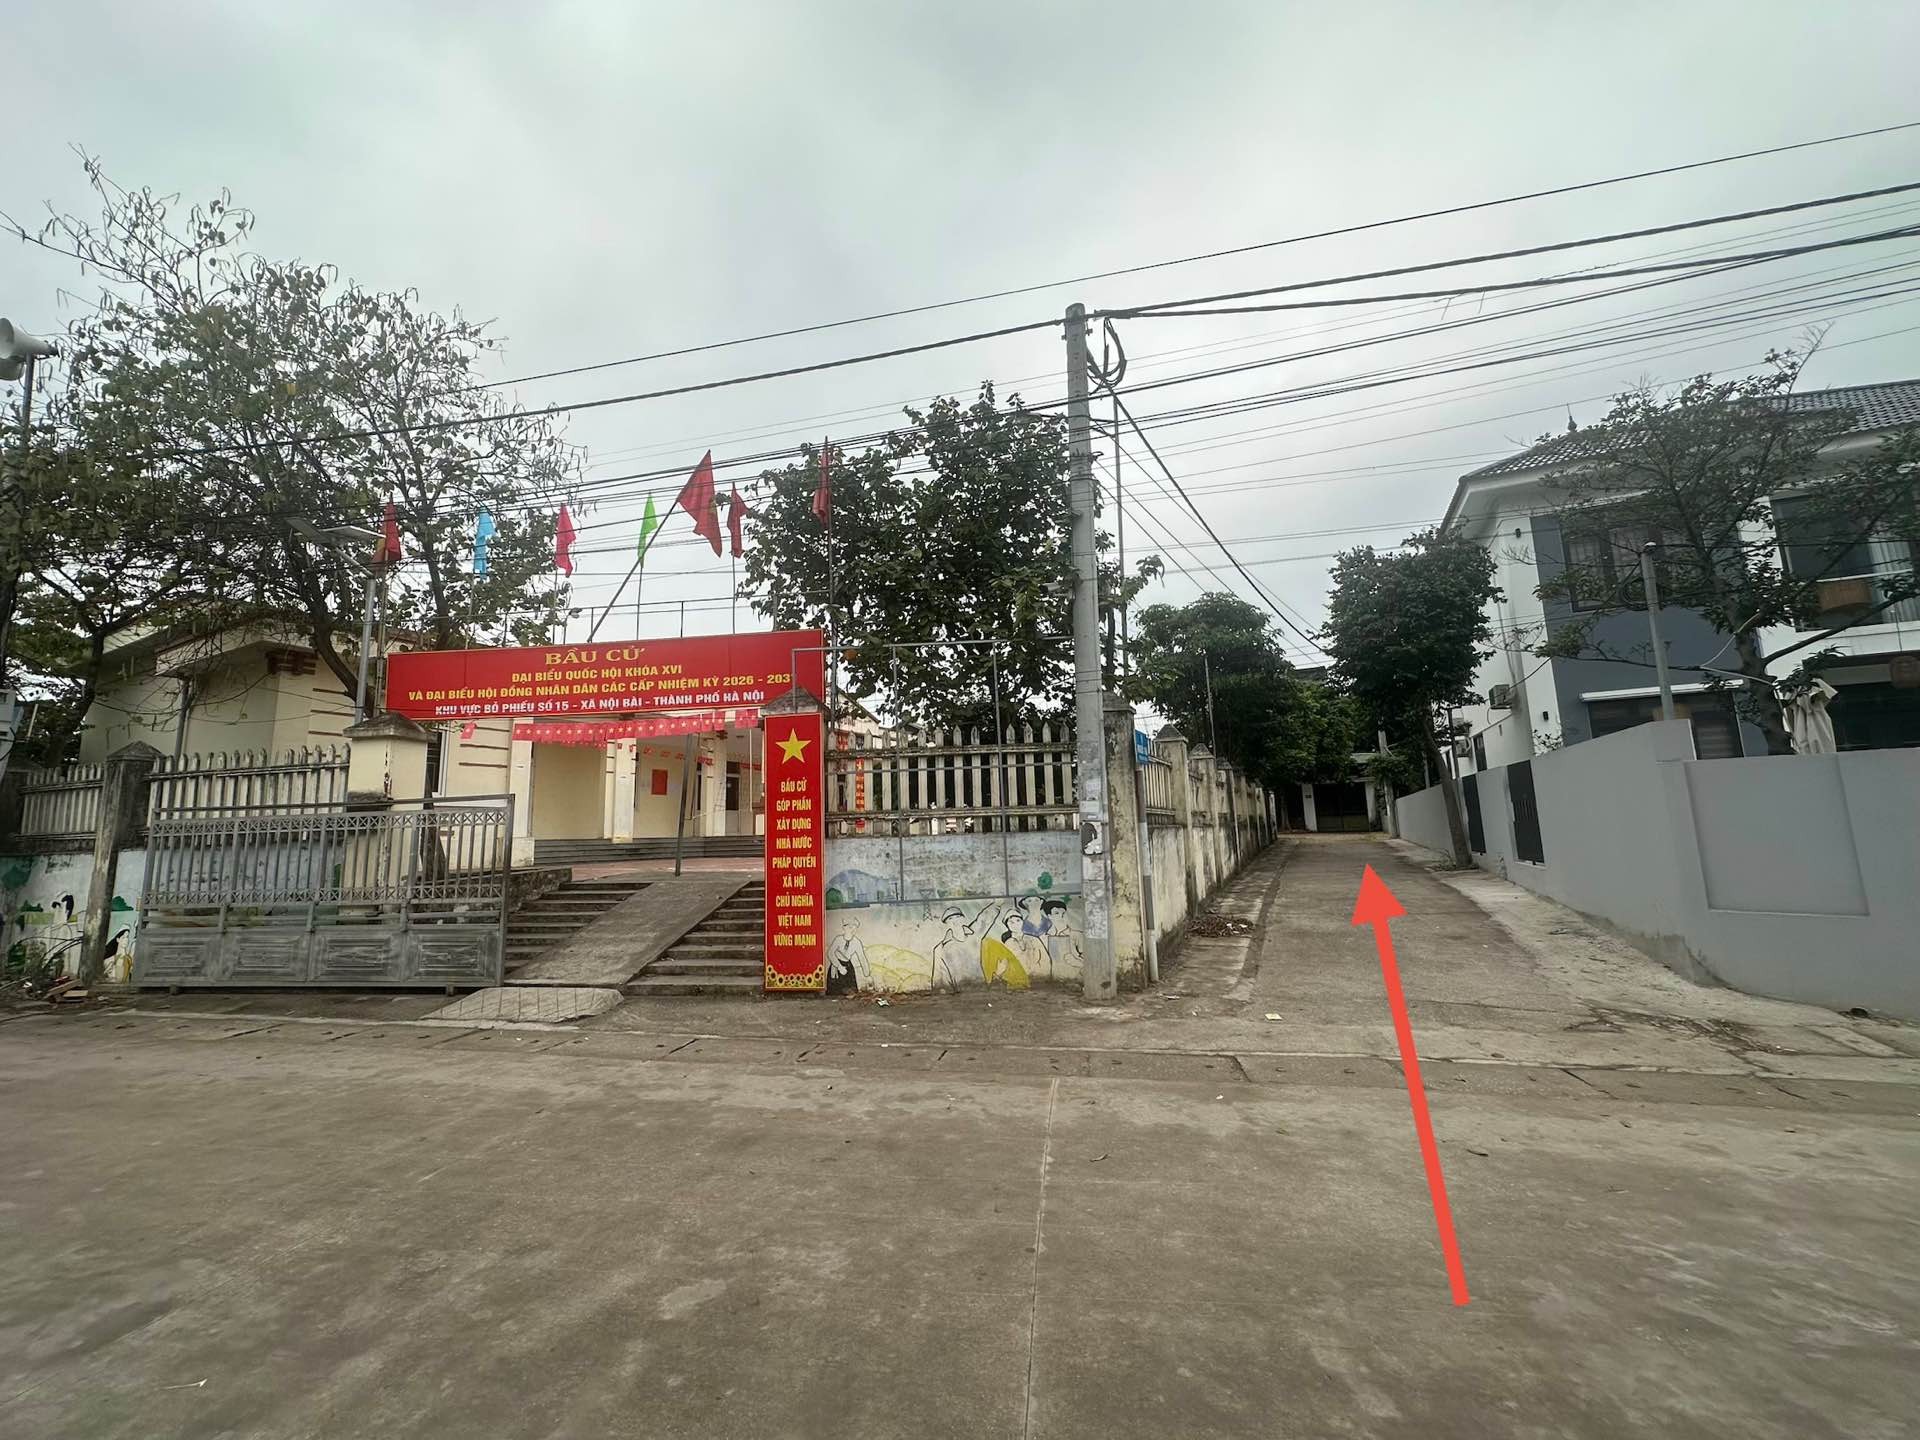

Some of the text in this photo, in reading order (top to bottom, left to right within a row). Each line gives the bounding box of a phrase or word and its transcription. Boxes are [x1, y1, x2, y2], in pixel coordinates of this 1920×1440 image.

[545, 645, 646, 665] BẦU CỬ
[511, 664, 682, 684] ĐẠI BIỂU QUỐC HỘI KHÓA XVI
[408, 689, 423, 701] VÀ
[426, 690, 445, 702] ĐẠI
[448, 686, 475, 699] BIỂU
[477, 687, 497, 700] HỘI
[500, 684, 533, 697] ĐỒNG
[536, 684, 570, 696] NHÂN
[572, 682, 598, 694] DÂN
[601, 681, 626, 693] CÁC
[629, 678, 655, 691] CẤP
[658, 677, 699, 691] NHIỆM
[703, 675, 720, 687] KỲ
[722, 675, 754, 686] 2026
[766, 673, 793, 684] 203
[435, 705, 457, 716] KHU
[459, 703, 481, 716] VỰC
[483, 700, 499, 714] BỎ
[501, 699, 535, 713] PHIẾU
[537, 698, 553, 712] SỐ
[555, 701, 569, 711] 15
[580, 698, 596, 710] XÃ
[599, 697, 619, 711] NỘI
[622, 696, 642, 708] BÀI
[653, 694, 692, 706] THÀNH
[695, 690, 720, 703] PHỐ
[723, 691, 739, 703] HÀ
[742, 689, 764, 703] NỘI
[781, 777, 807, 792] BẦU CỬ
[776, 796, 811, 811] GÓP PHẦN
[776, 816, 811, 832] XÂY DỰNG
[776, 834, 812, 849] NHÀ NƯỚC
[772, 855, 791, 868] PHÁP
[782, 873, 806, 889] XÃ HỘI
[776, 892, 813, 907] CHỦ NGHĨA
[778, 912, 812, 929] VIỆT NAM
[773, 932, 816, 949] VỮNG MẠNH
